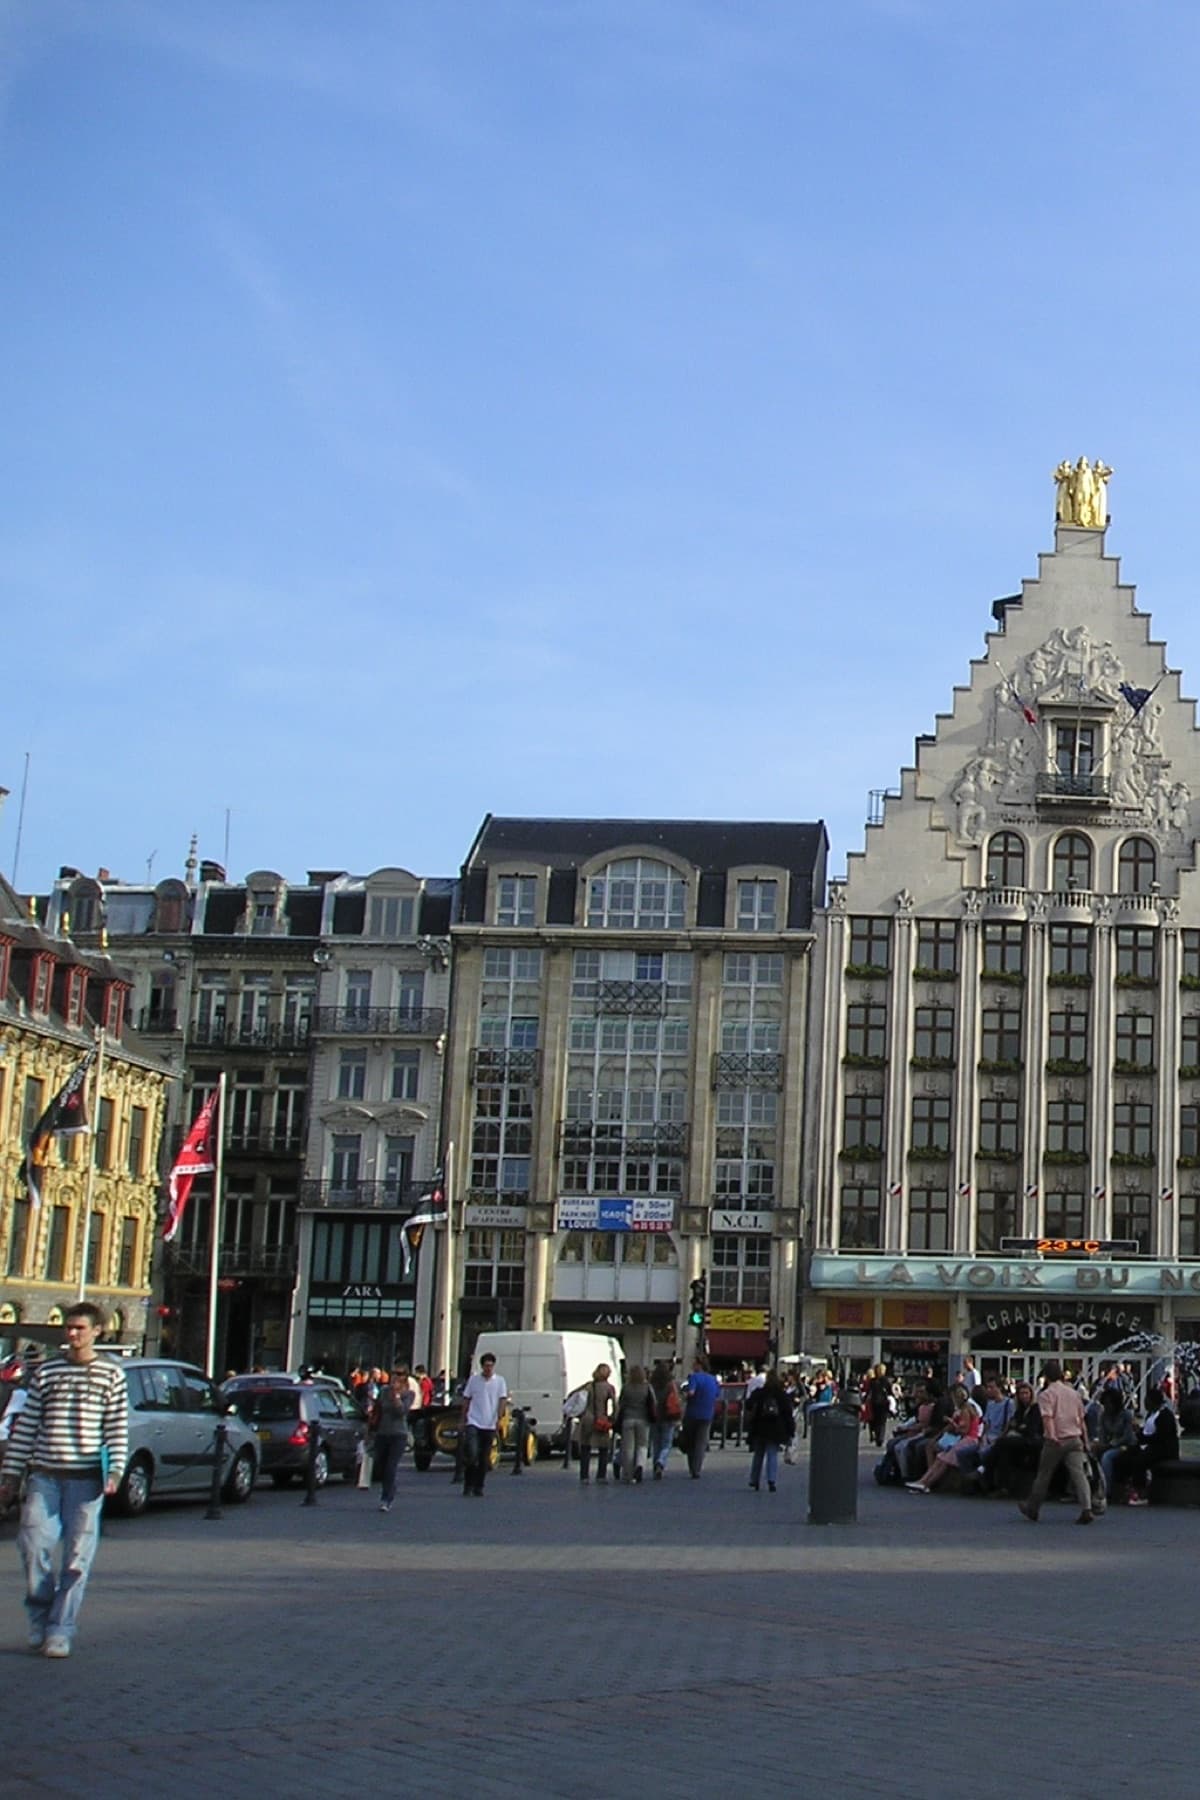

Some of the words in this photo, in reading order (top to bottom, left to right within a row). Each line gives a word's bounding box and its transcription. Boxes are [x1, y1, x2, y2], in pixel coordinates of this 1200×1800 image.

[722, 1214, 763, 1228] N.C.I.
[856, 1262, 914, 1285] LA
[935, 1262, 1044, 1288] VOIX
[1075, 1267, 1130, 1290] DU
[342, 1285, 383, 1297] ZARA
[593, 1313, 635, 1325] ZARA
[1075, 1303, 1141, 1333] PLACE
[1027, 1317, 1097, 1340] fnac
